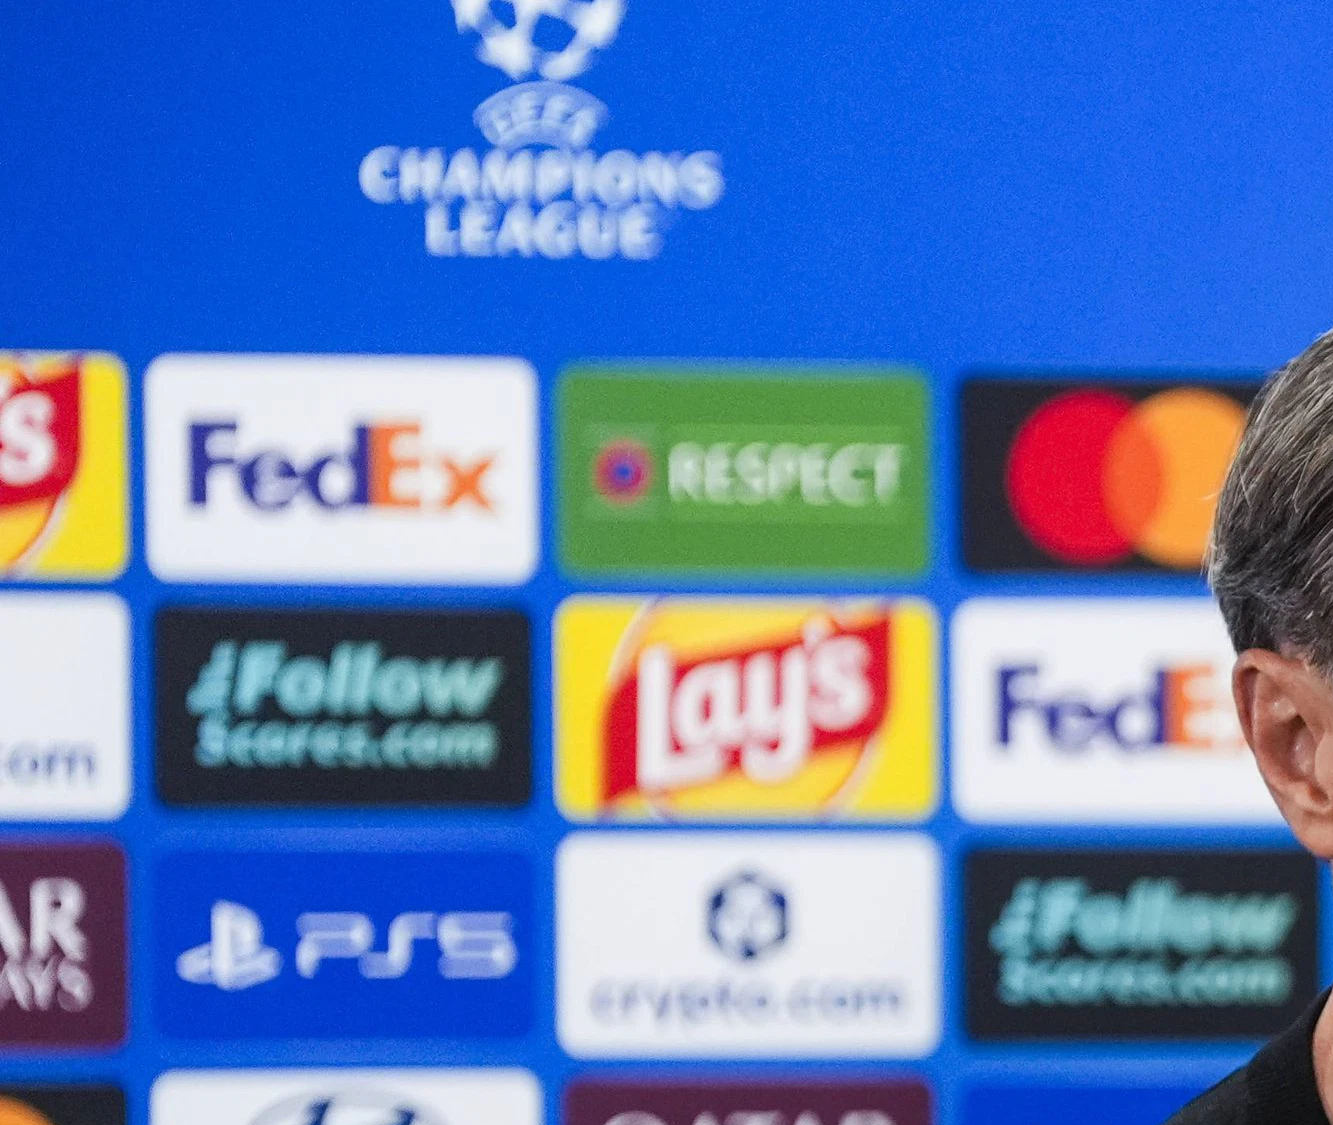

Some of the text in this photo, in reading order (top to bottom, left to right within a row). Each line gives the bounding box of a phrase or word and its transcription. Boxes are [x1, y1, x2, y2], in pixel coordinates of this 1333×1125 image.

[359, 146, 724, 210] CHAMPIONS
[425, 201, 662, 260] LEAGUE
[187, 418, 496, 513] FedEx
[668, 441, 904, 505] RESPECT
[637, 616, 872, 790] Lay's
[996, 664, 1238, 750] FedE
[297, 911, 518, 981] PS5
[590, 980, 905, 1028] crypto.com
